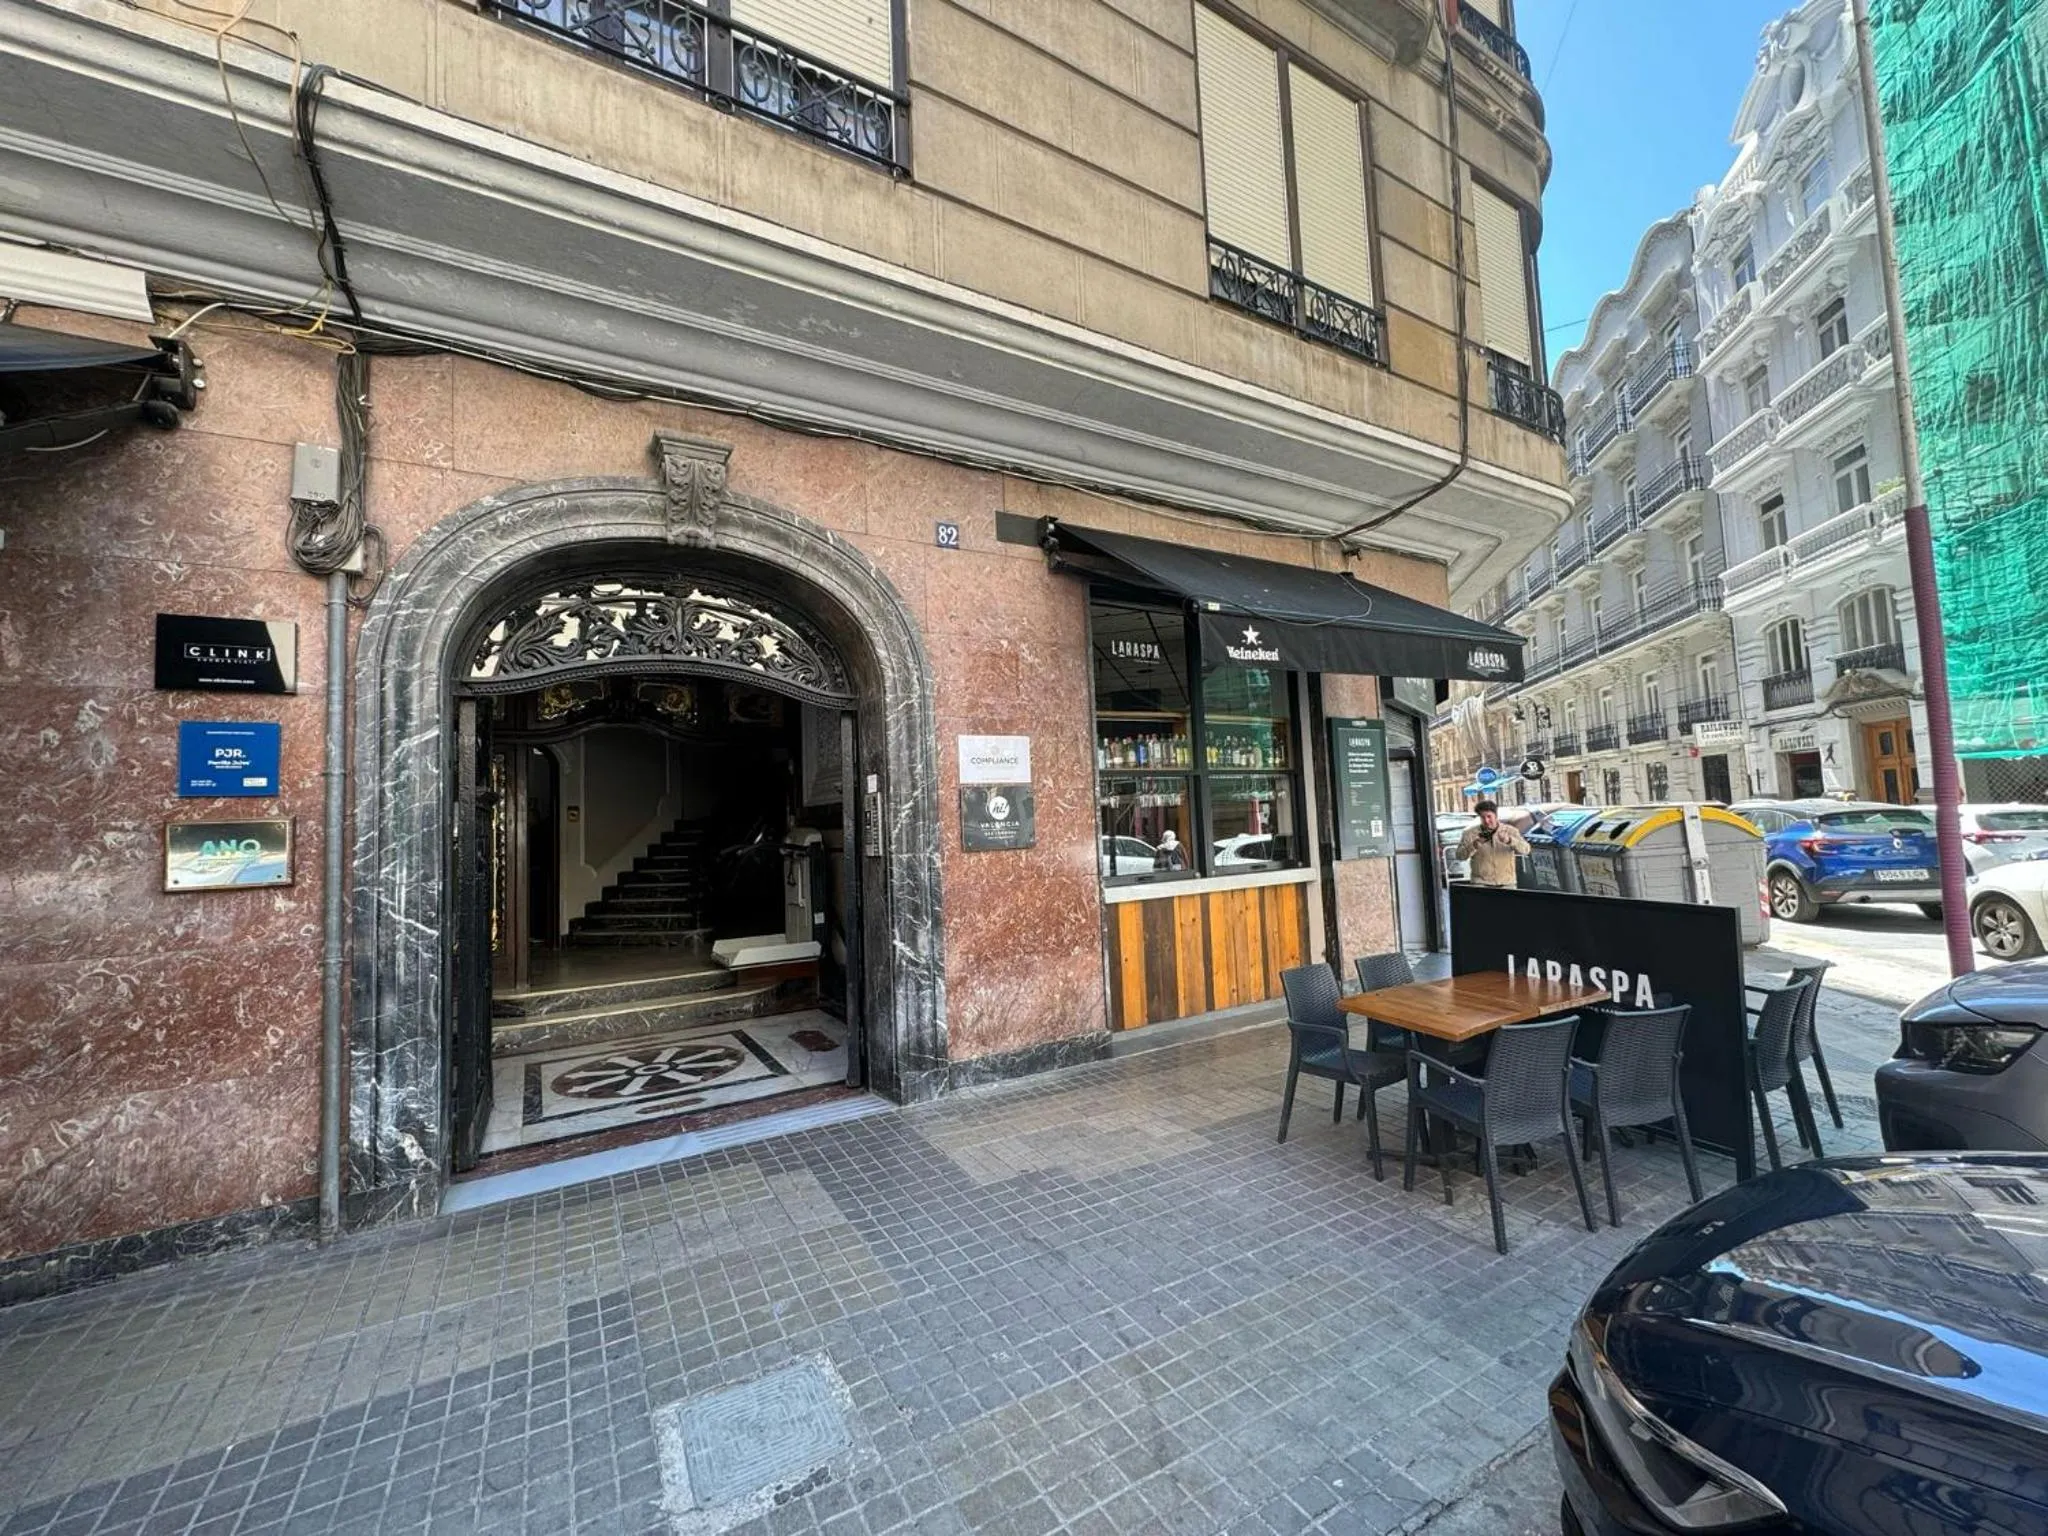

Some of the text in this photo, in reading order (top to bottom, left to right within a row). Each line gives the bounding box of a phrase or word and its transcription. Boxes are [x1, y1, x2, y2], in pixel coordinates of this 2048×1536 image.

[938, 525, 957, 545] 82
[189, 646, 266, 659] CLINK
[1111, 640, 1160, 659] LARASPA
[1226, 645, 1280, 662] Heineken
[1468, 651, 1507, 668] LARASPA
[970, 756, 1018, 764] COMPLIANCE
[980, 821, 1020, 829] VALENCIA
